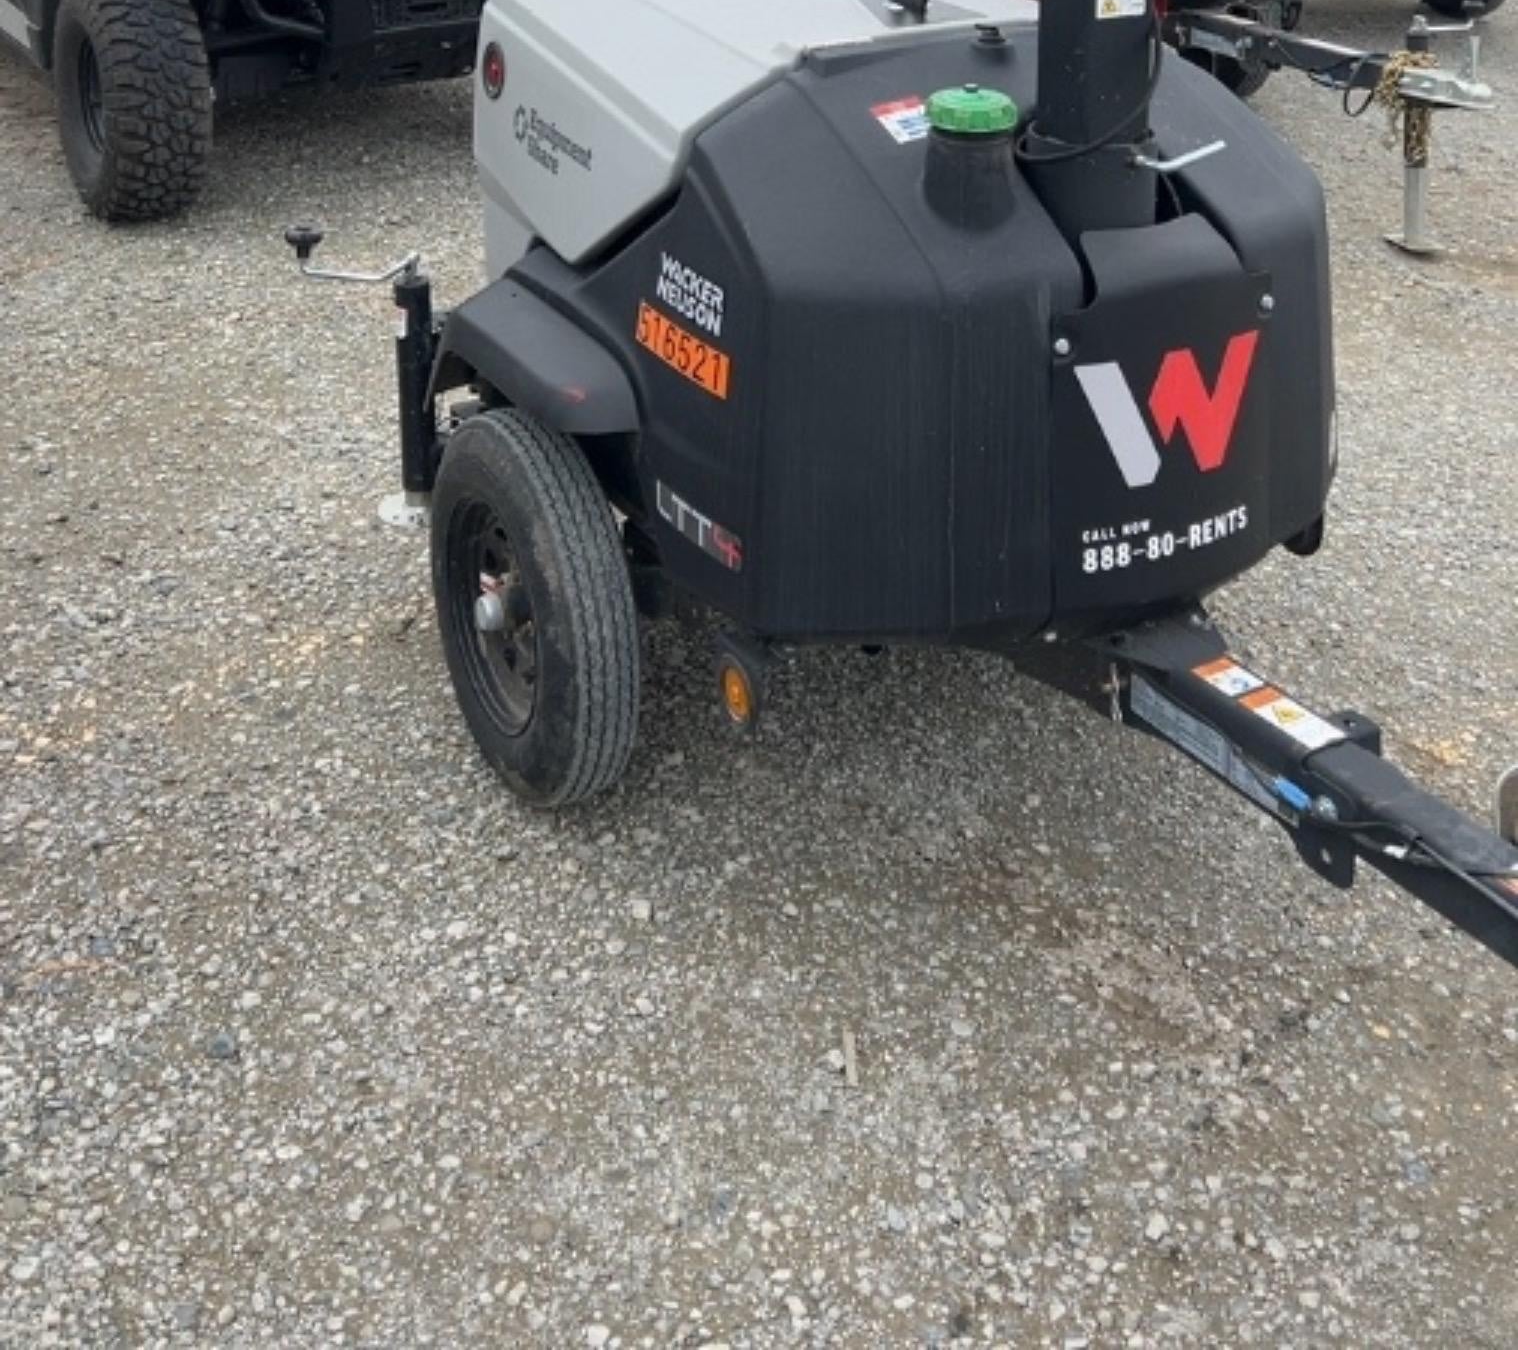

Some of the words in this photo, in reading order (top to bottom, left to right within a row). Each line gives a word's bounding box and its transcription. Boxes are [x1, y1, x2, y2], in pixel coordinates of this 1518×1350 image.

[527, 134, 559, 175] Share
[530, 107, 592, 172] Equipment
[656, 274, 722, 338] NEUSON
[661, 251, 725, 313] WACKER
[641, 304, 722, 392] 516521
[1081, 504, 1248, 575] 888-80-RENTS
[1082, 526, 1117, 544] CALL
[1120, 518, 1151, 536] NOW
